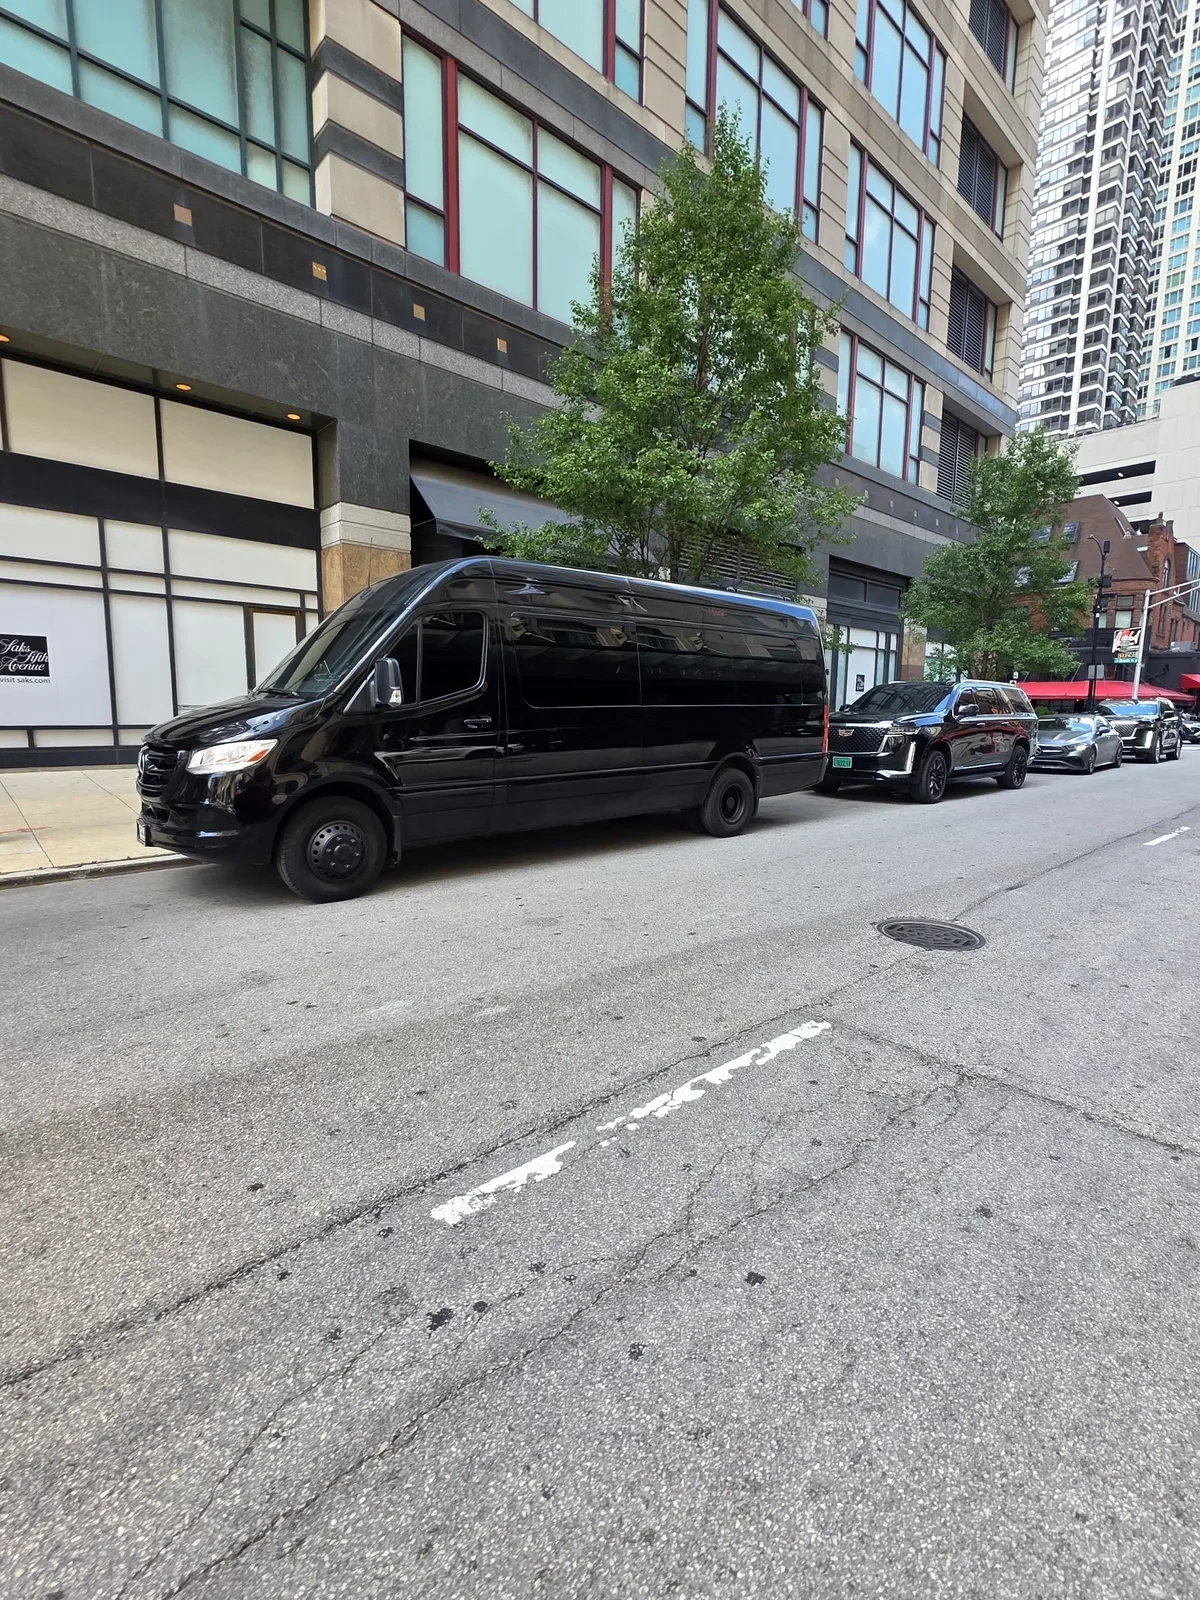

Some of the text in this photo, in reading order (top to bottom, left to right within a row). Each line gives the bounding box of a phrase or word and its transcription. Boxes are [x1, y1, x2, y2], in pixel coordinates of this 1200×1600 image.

[0, 638, 30, 654] Saks
[22, 650, 49, 664] Fifth
[1, 658, 45, 672] Avenue
